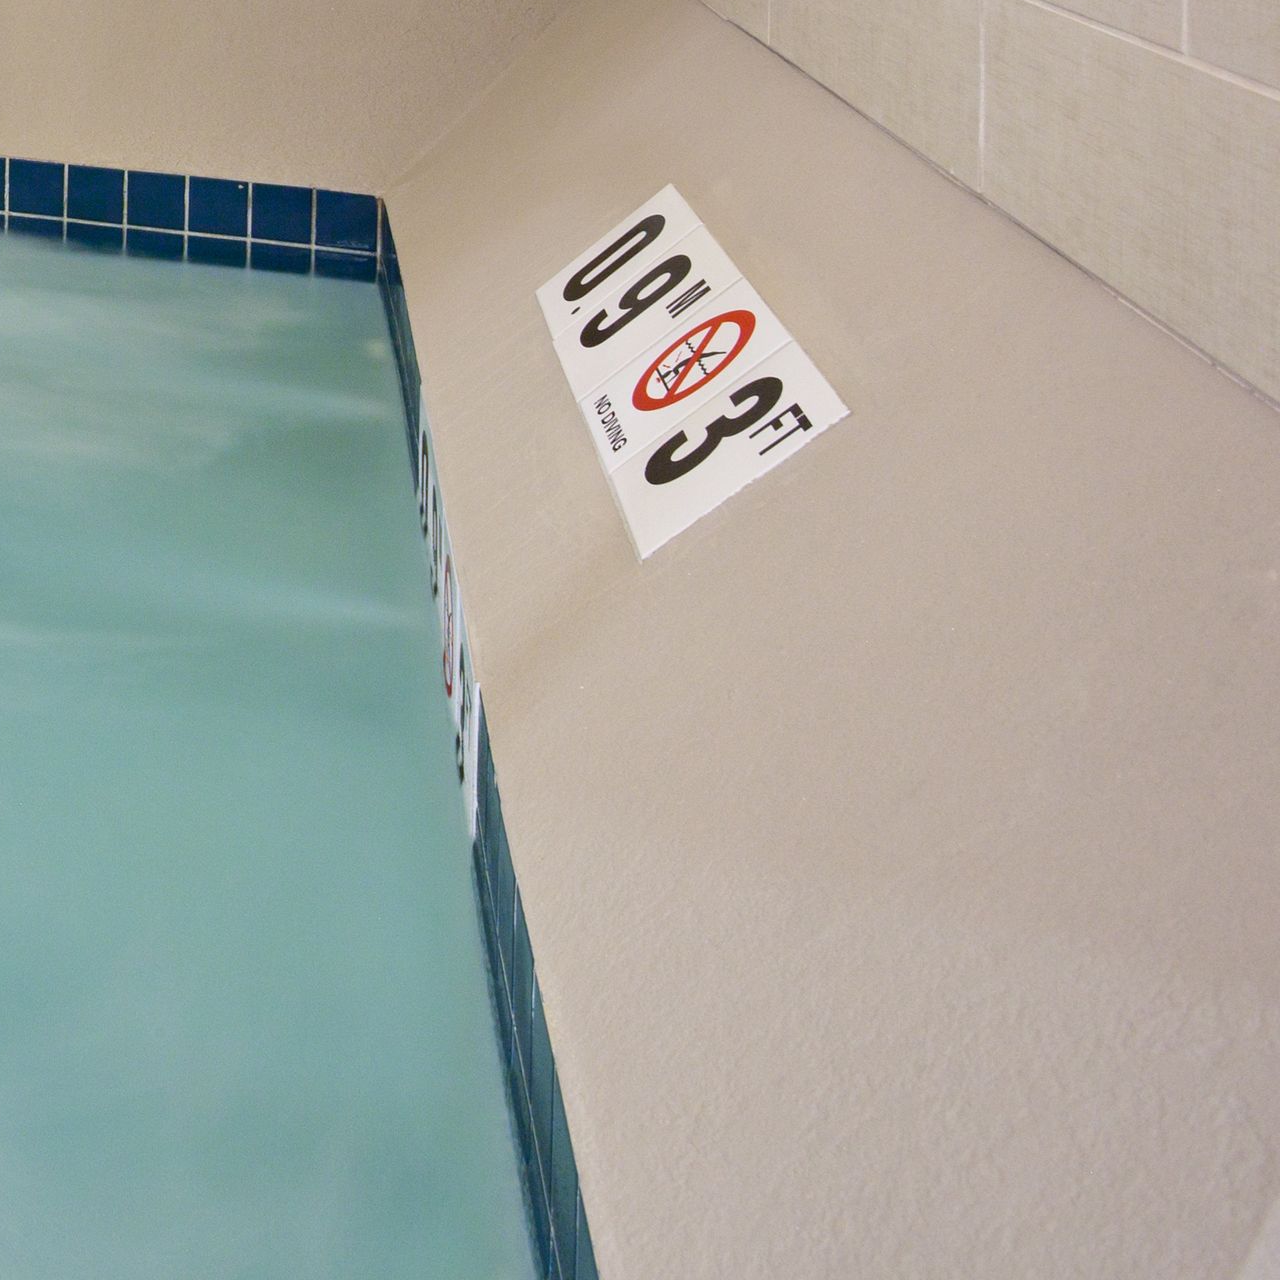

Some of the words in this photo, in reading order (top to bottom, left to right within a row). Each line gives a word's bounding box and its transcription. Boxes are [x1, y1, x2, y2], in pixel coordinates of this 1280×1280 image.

[665, 278, 712, 320] M
[593, 393, 608, 416] NO
[600, 411, 628, 453] DIVING
[644, 376, 784, 486] 3
[749, 402, 813, 457] FT
